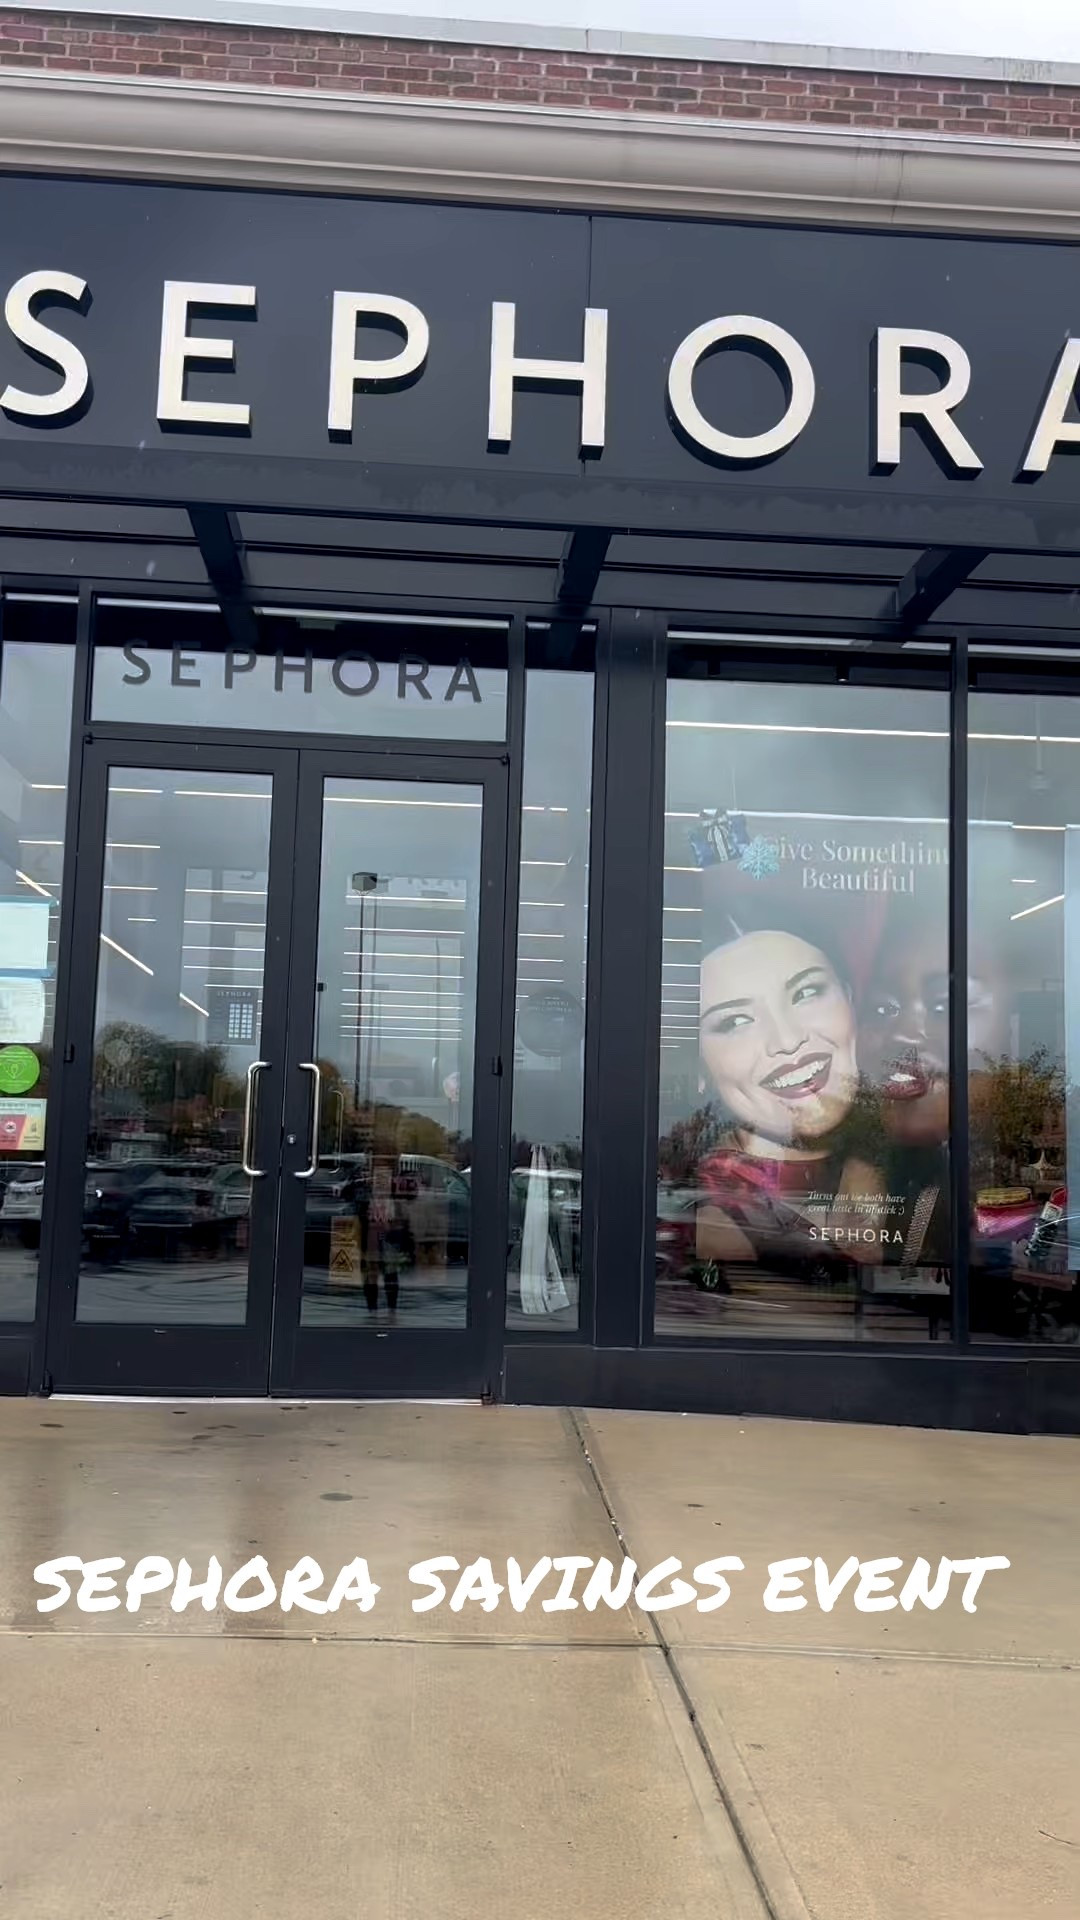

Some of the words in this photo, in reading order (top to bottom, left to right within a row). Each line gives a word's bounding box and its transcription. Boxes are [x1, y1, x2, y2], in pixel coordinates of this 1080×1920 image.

[122, 638, 482, 703] SEPHORA
[776, 836, 813, 861] ive
[802, 867, 915, 893] Beautiful
[808, 1190, 833, 1201] Turns
[864, 1192, 884, 1202] both
[885, 1193, 906, 1204] have
[809, 1227, 904, 1243] SEPHORA
